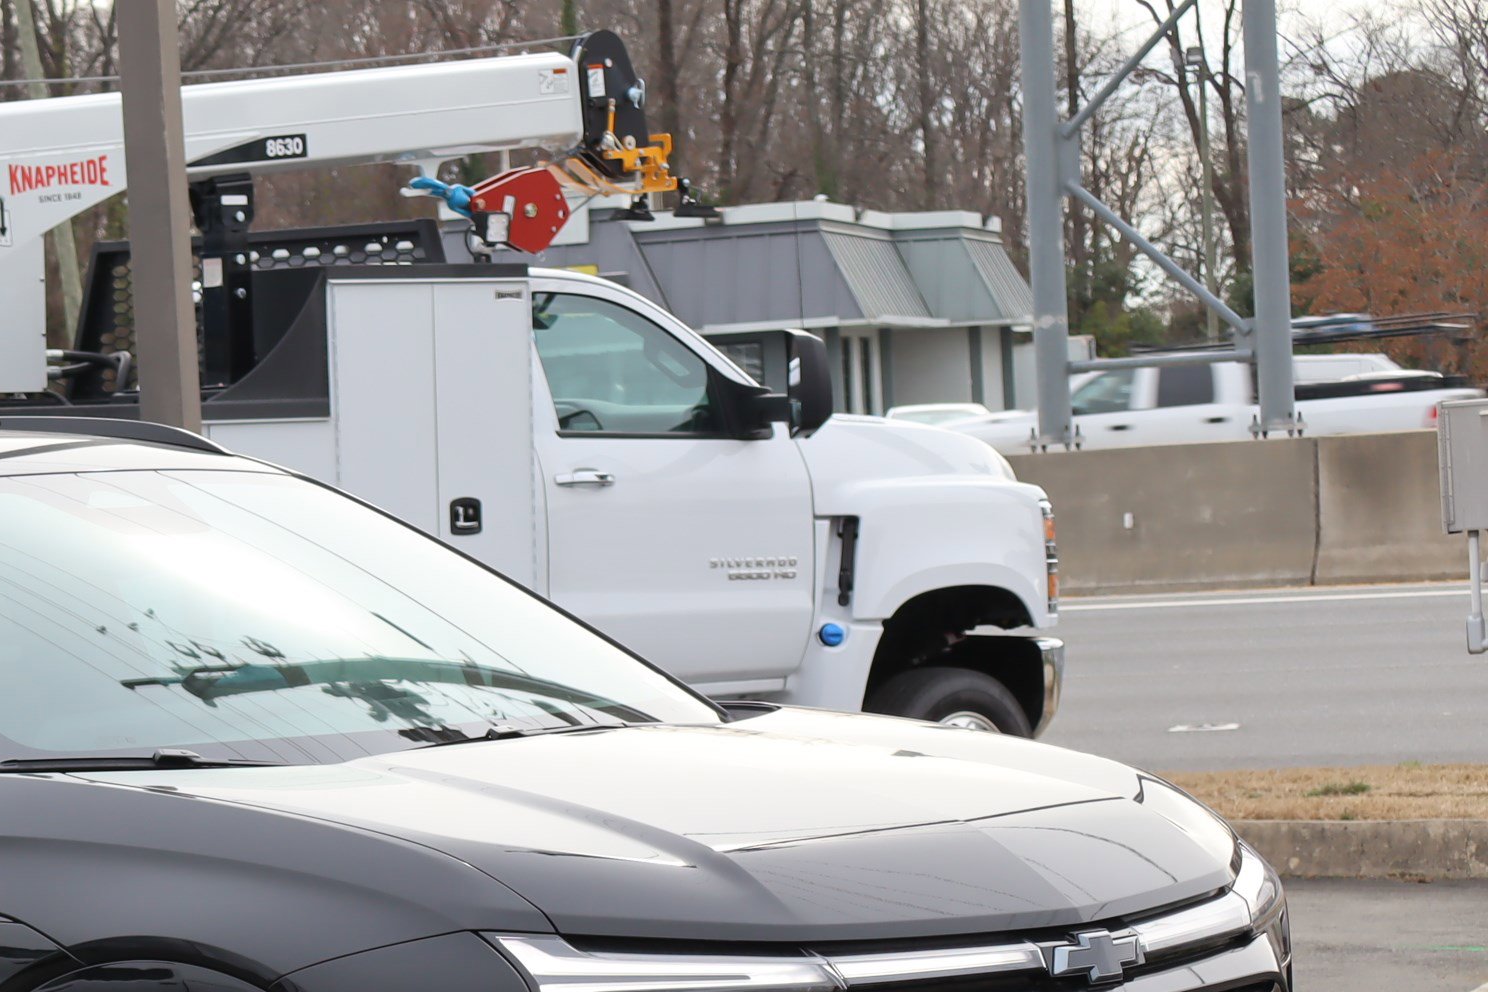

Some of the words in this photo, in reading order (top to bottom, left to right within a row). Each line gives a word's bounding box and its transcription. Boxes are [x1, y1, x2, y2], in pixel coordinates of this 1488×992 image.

[266, 136, 303, 157] 8630
[8, 154, 109, 195] KNAPHEIDE
[709, 558, 798, 569] SILVERADO
